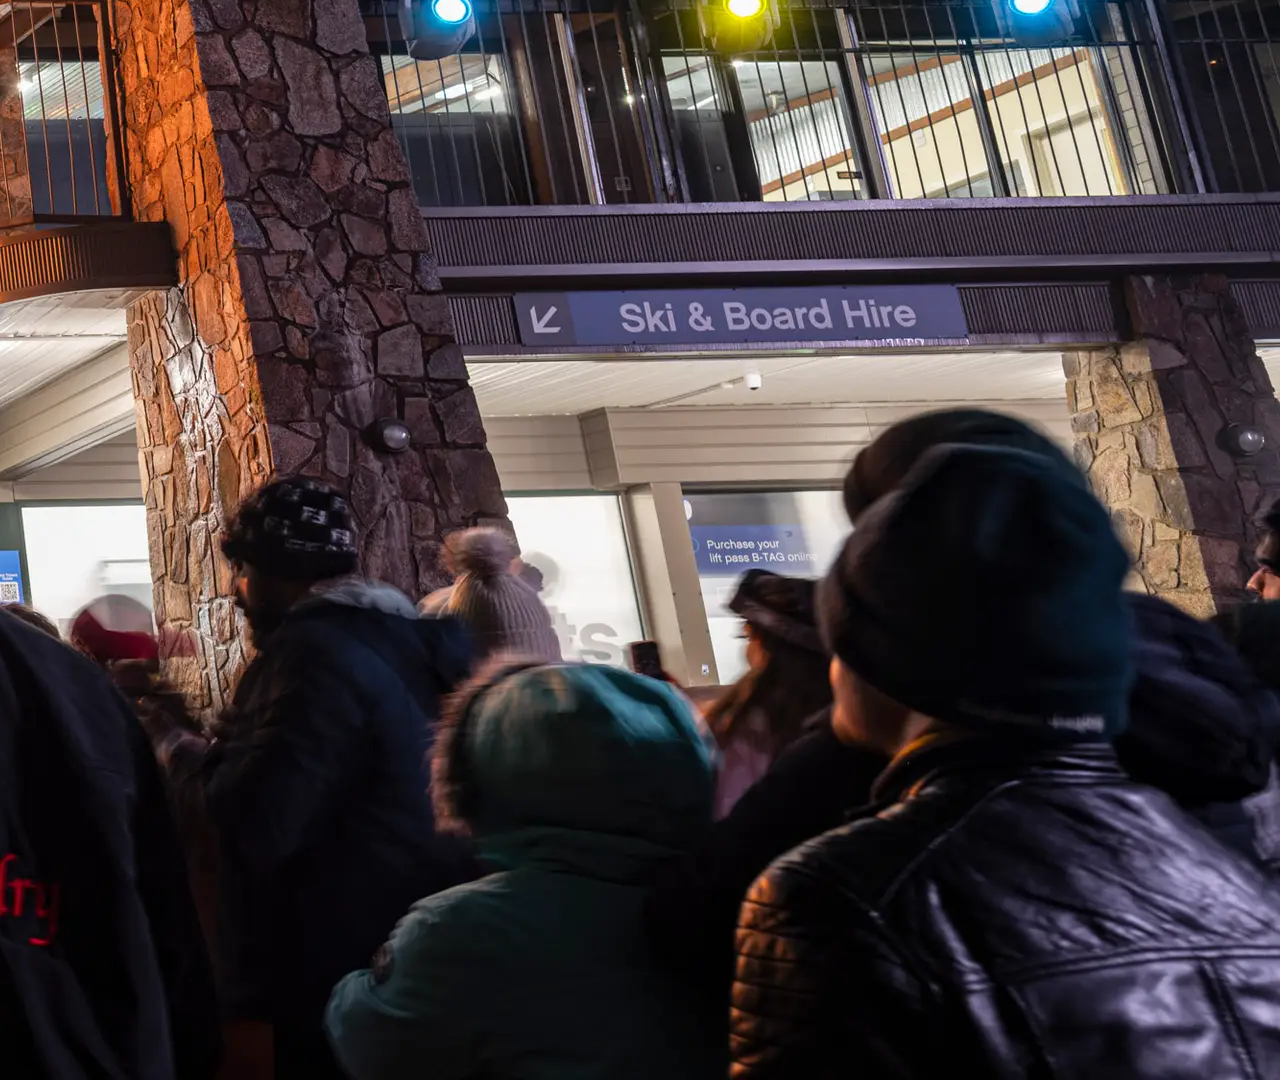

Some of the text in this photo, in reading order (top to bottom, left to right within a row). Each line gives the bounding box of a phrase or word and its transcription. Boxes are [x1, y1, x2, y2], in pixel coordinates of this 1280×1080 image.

[619, 298, 917, 333] Ski & Board Hire
[706, 539, 780, 551] Purchase your
[708, 552, 723, 564] lift
[724, 554, 750, 565] pass
[751, 552, 786, 563] B-TAG
